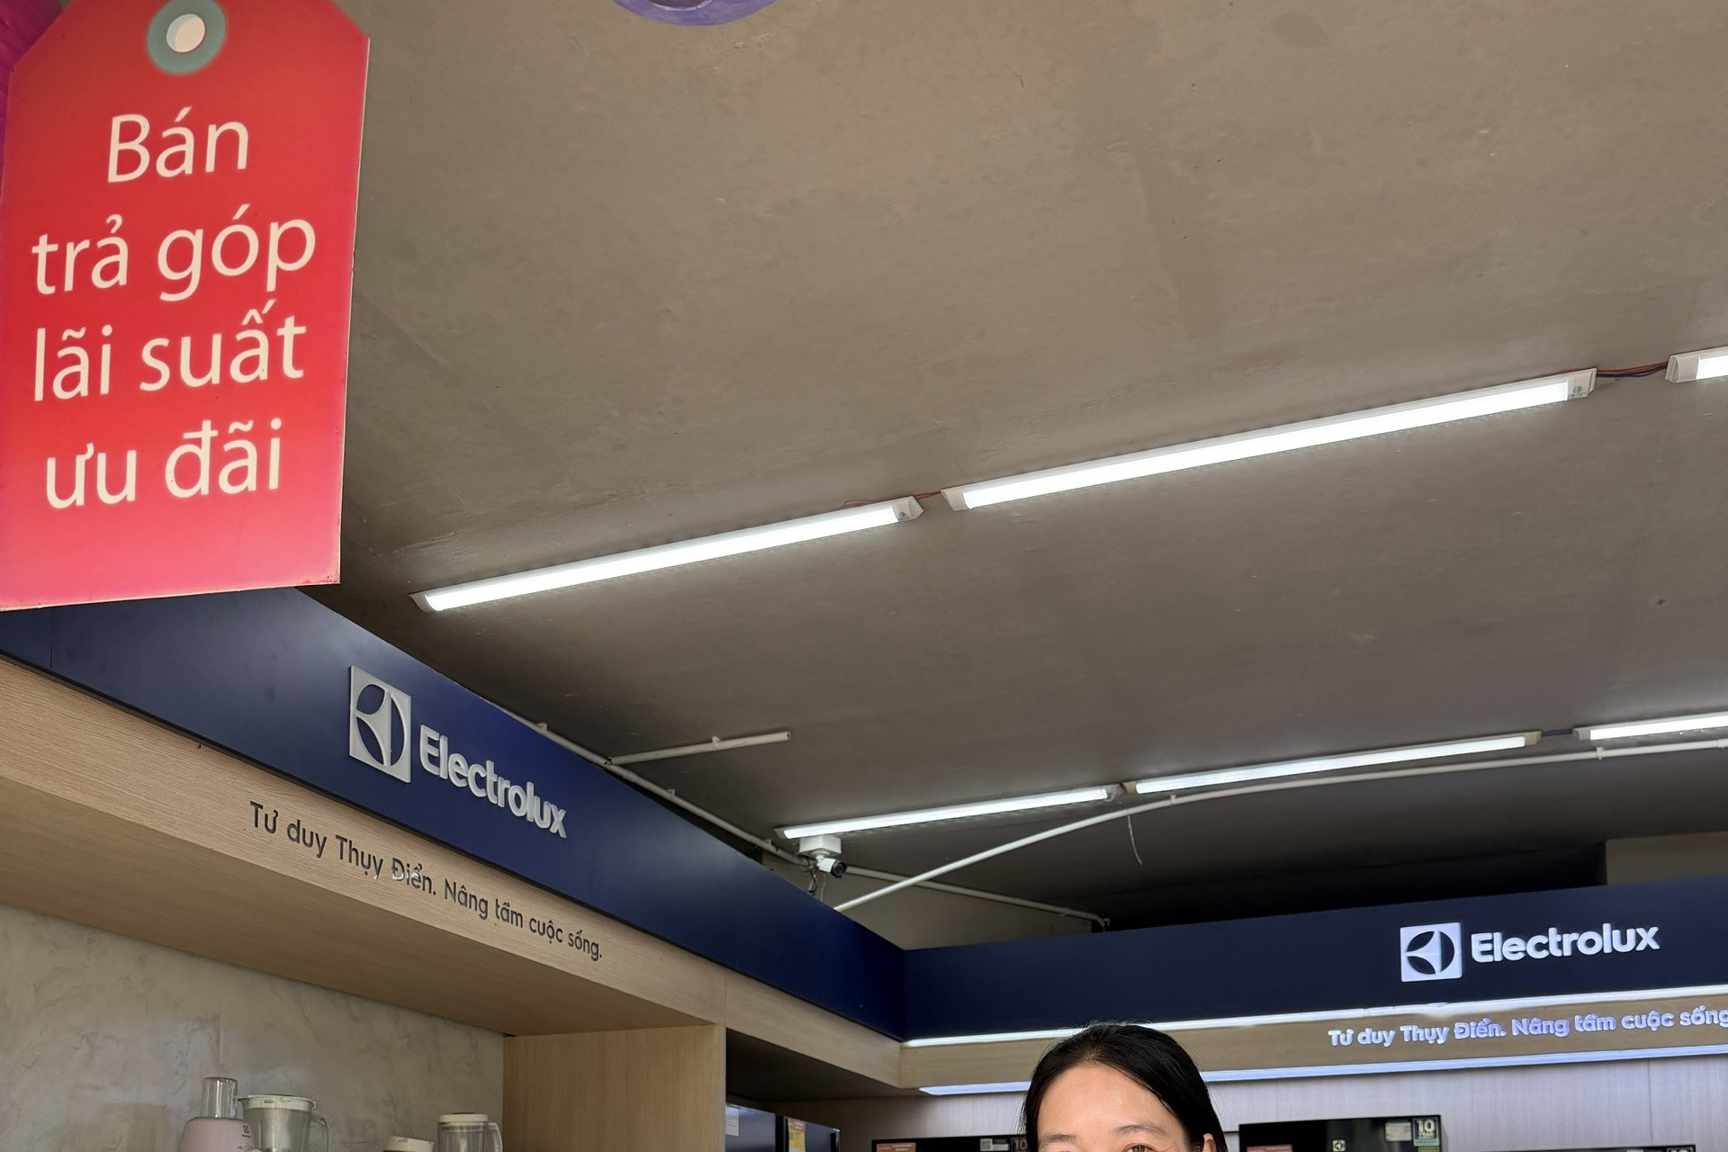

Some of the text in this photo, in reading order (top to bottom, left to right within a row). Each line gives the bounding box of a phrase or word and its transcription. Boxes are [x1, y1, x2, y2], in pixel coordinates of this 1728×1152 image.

[106, 106, 250, 184] Bán
[32, 204, 317, 303] trả góp
[33, 299, 307, 402] lãi suất
[45, 418, 283, 509] ưu đãi
[419, 724, 568, 839] Electrolux
[249, 800, 279, 834] Tư
[286, 819, 328, 859] duy
[335, 834, 384, 880] Thụy
[444, 877, 489, 921] Nâng
[495, 898, 524, 929] tầm
[528, 917, 564, 945] cuộc
[567, 929, 603, 961] sống.
[1470, 923, 1661, 964] Electrolux
[1327, 1028, 1354, 1047] Tư
[1357, 1027, 1396, 1048] duy
[1399, 1023, 1450, 1045] Thụy
[1511, 1017, 1570, 1038] Nâng
[1621, 1010, 1675, 1032] cuộc
[1416, 1119, 1435, 1132] 10
